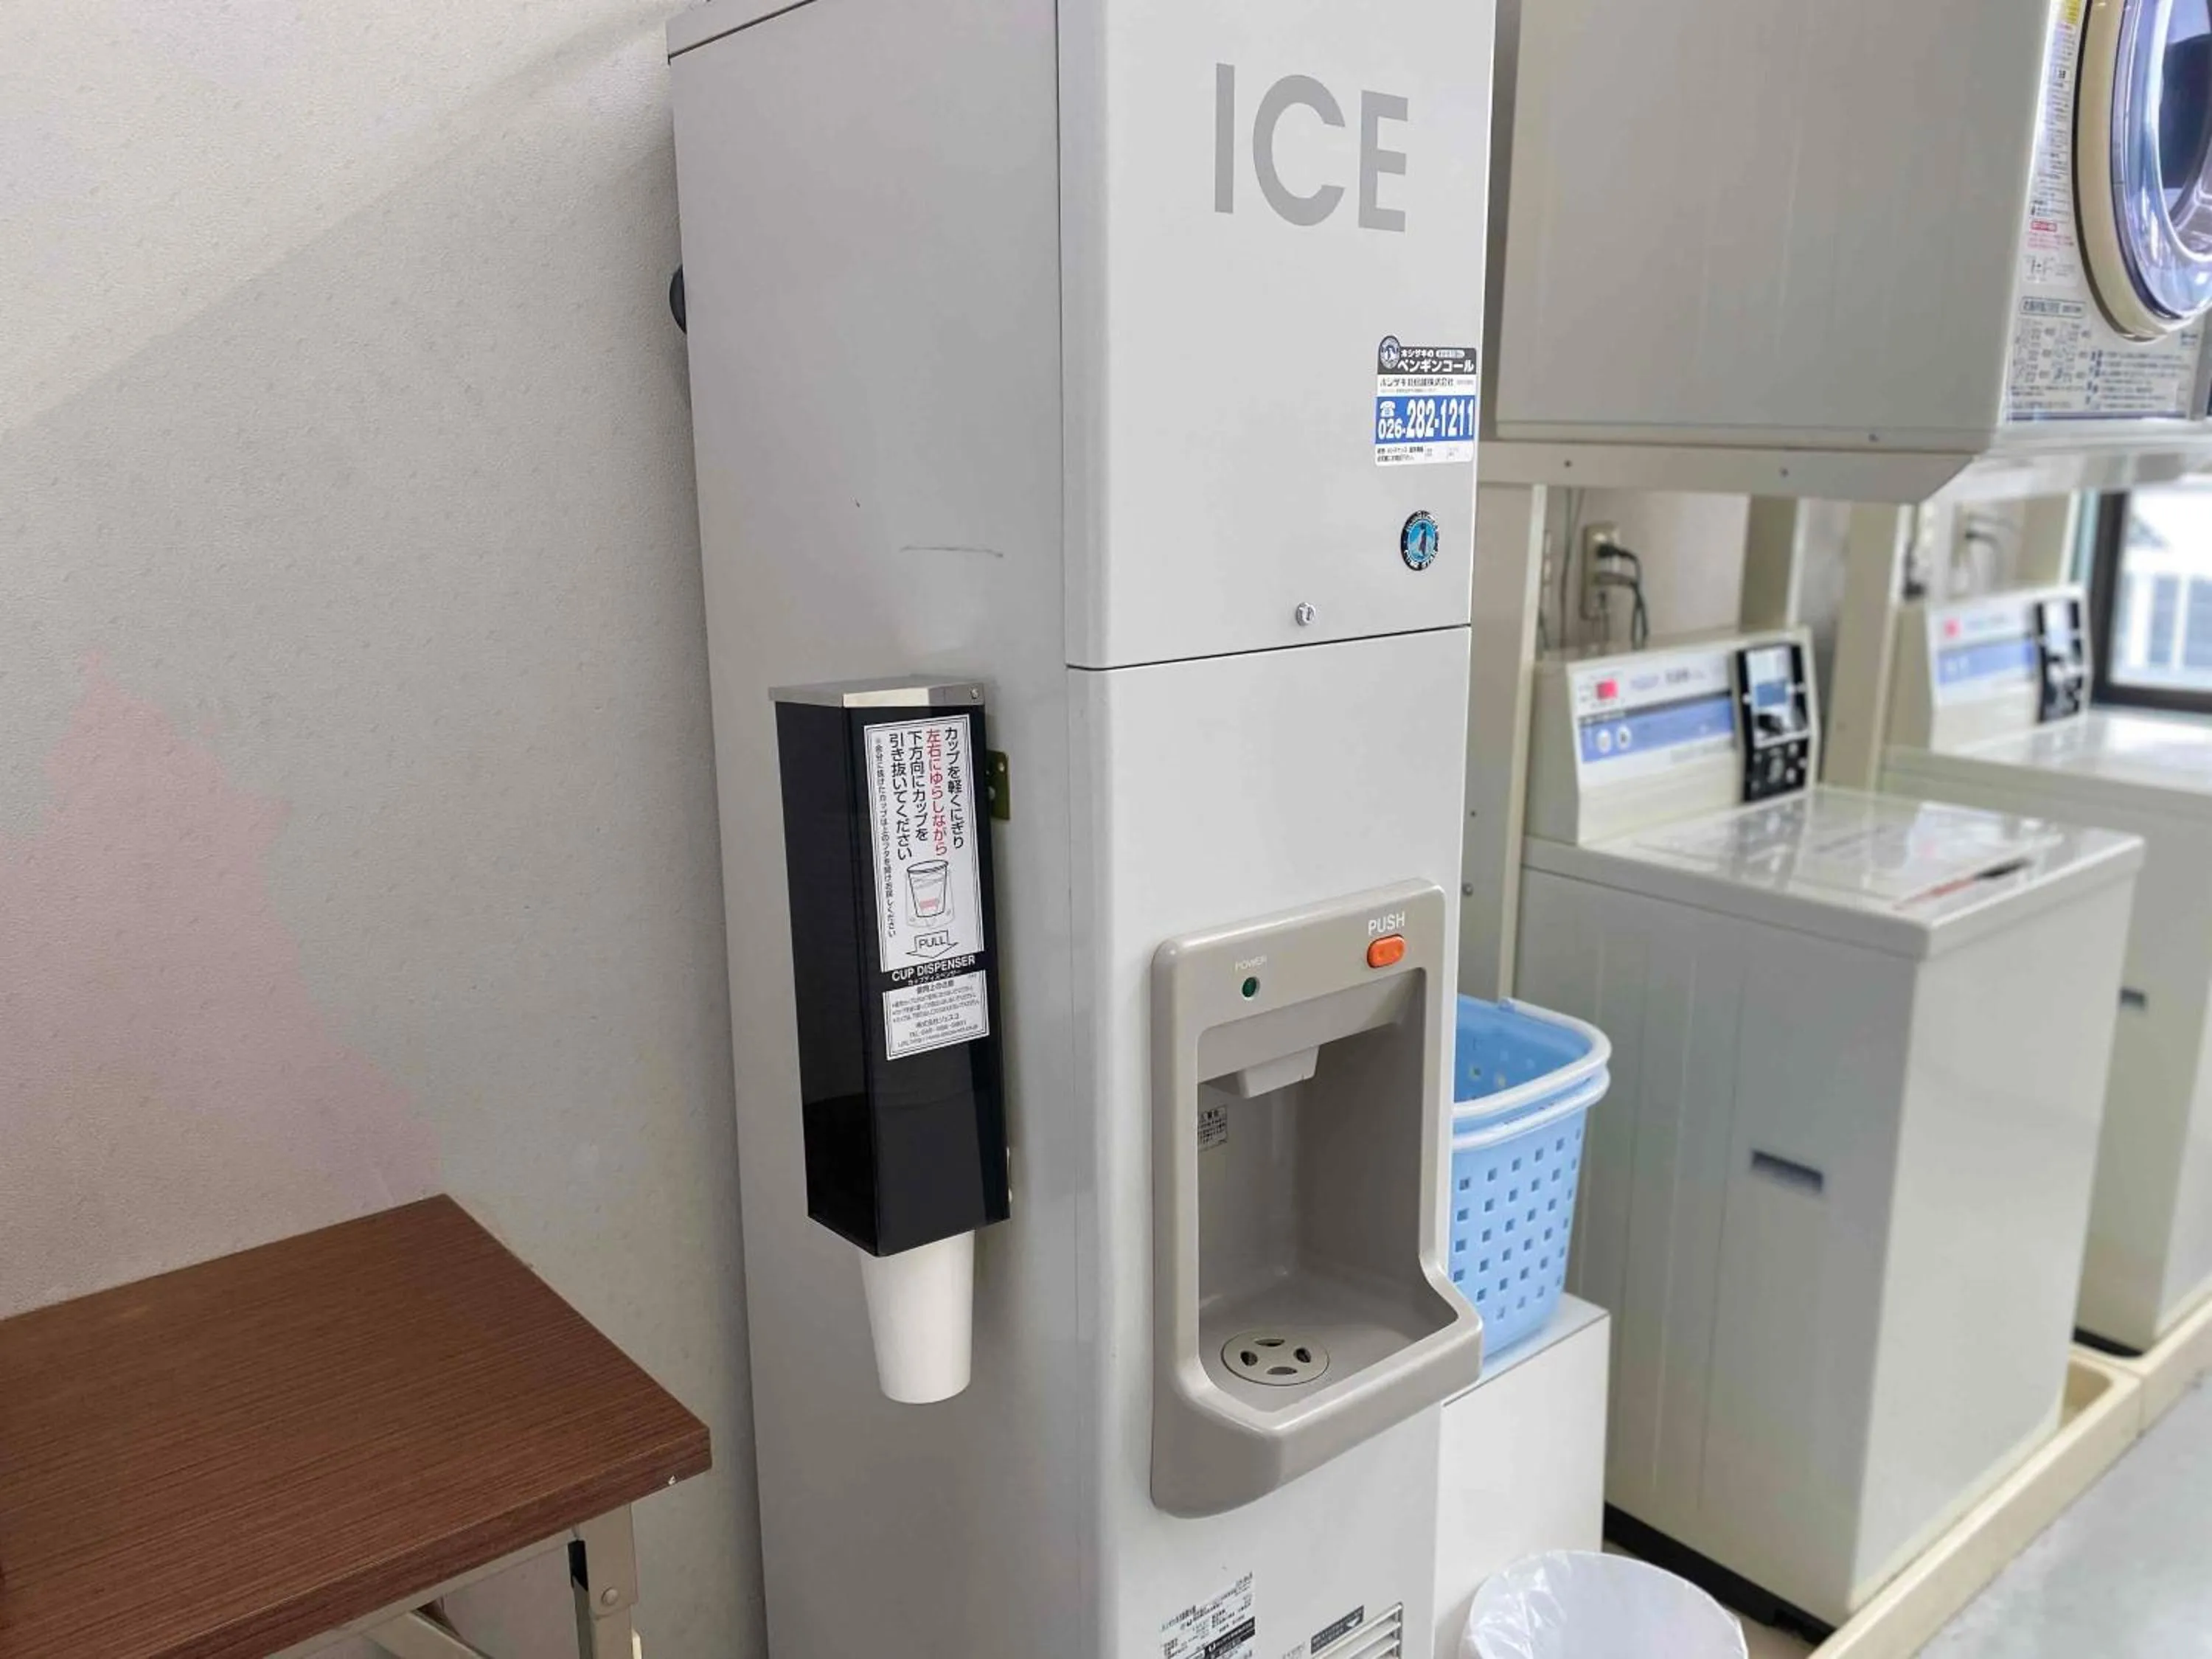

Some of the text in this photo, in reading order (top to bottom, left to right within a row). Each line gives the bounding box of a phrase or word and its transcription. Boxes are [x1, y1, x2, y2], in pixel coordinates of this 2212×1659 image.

[1214, 62, 1408, 232] ICE
[1397, 359, 1474, 372] ペンギンコール
[889, 732, 912, 861] 引き抜いてください
[908, 730, 928, 842] 下方向にカップを
[926, 728, 948, 857] 左右にゆらしながら
[945, 727, 965, 850] カップを軽くにぎり
[919, 935, 945, 950] PULL
[1368, 911, 1405, 935] PUSH
[891, 955, 975, 981] CUP DISPENSER
[1234, 955, 1267, 971] POWER
